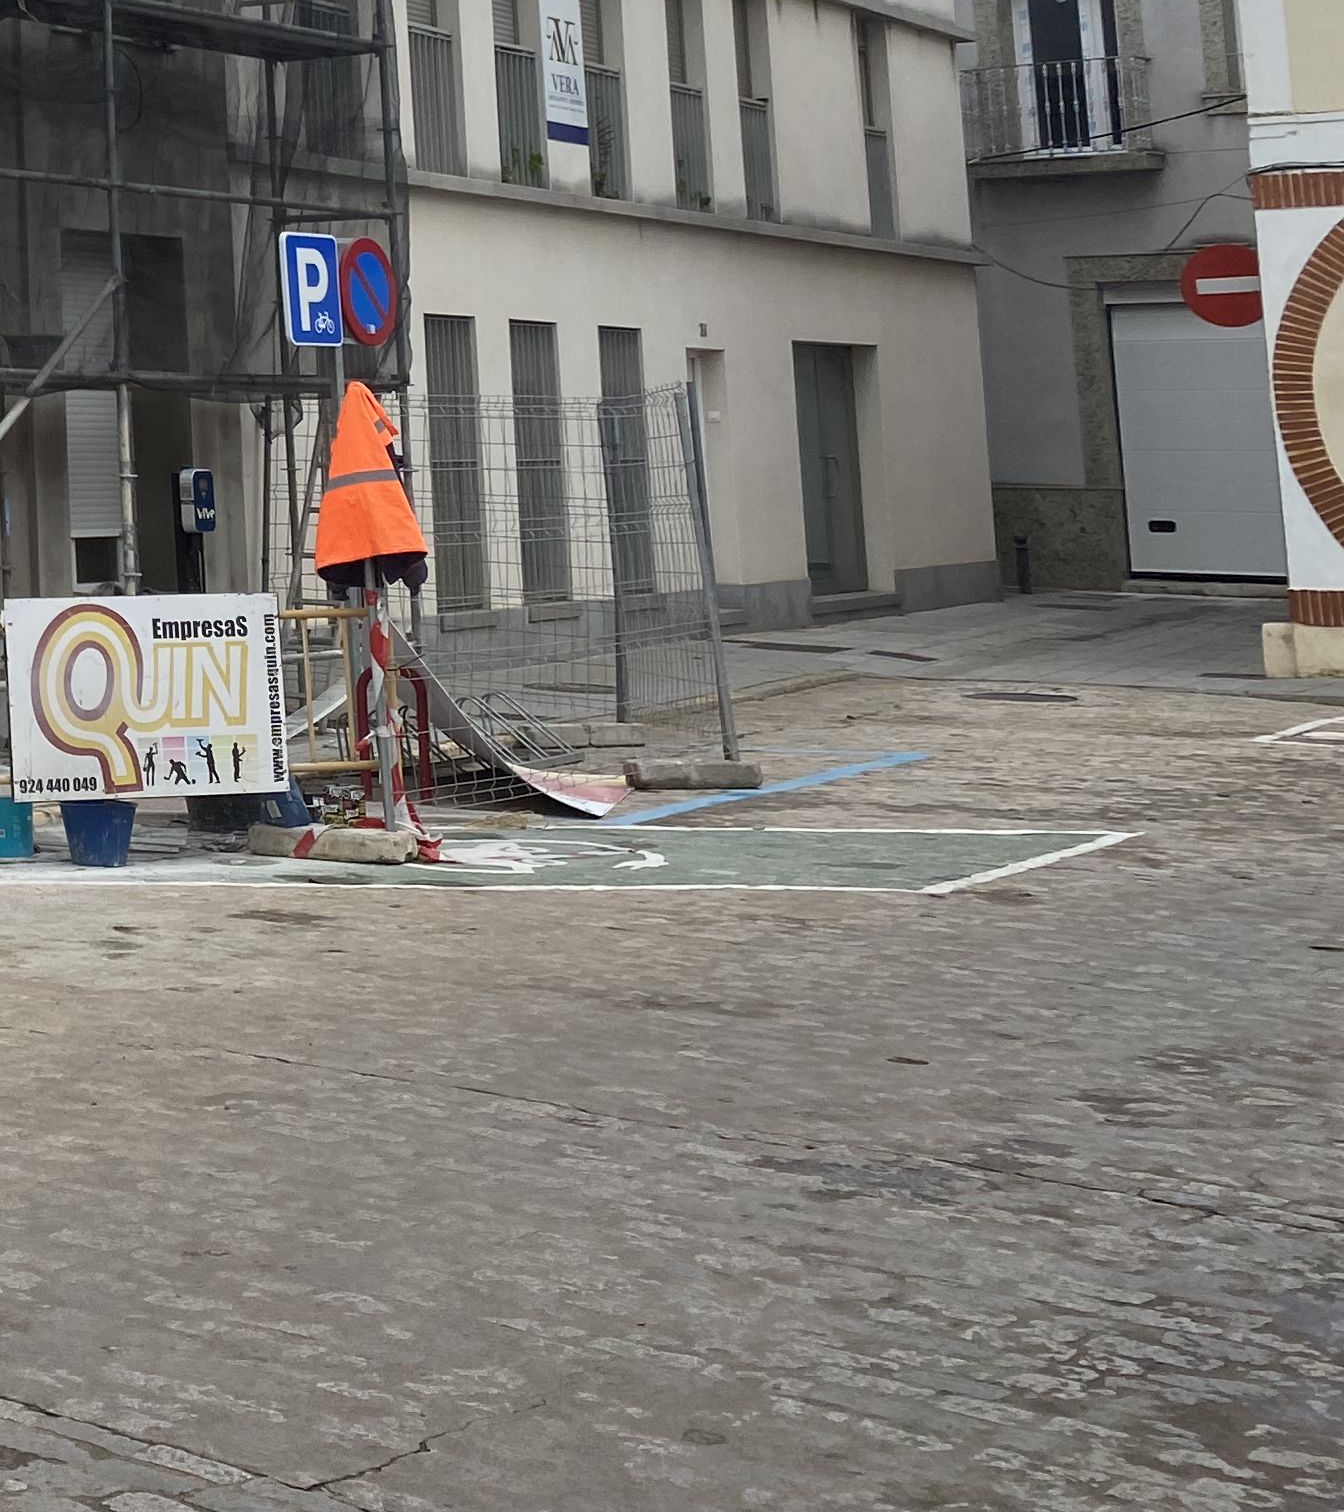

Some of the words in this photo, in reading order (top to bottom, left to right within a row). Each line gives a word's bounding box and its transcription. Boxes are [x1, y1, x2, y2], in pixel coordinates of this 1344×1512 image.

[551, 73, 579, 96] VERA
[296, 247, 329, 332] P
[152, 616, 247, 640] EmpresaS
[31, 603, 248, 794] QUIN
[264, 613, 286, 782] www.empresasquin.com
[20, 778, 43, 793] 924
[47, 778, 70, 792] 440
[73, 777, 97, 791] 049
